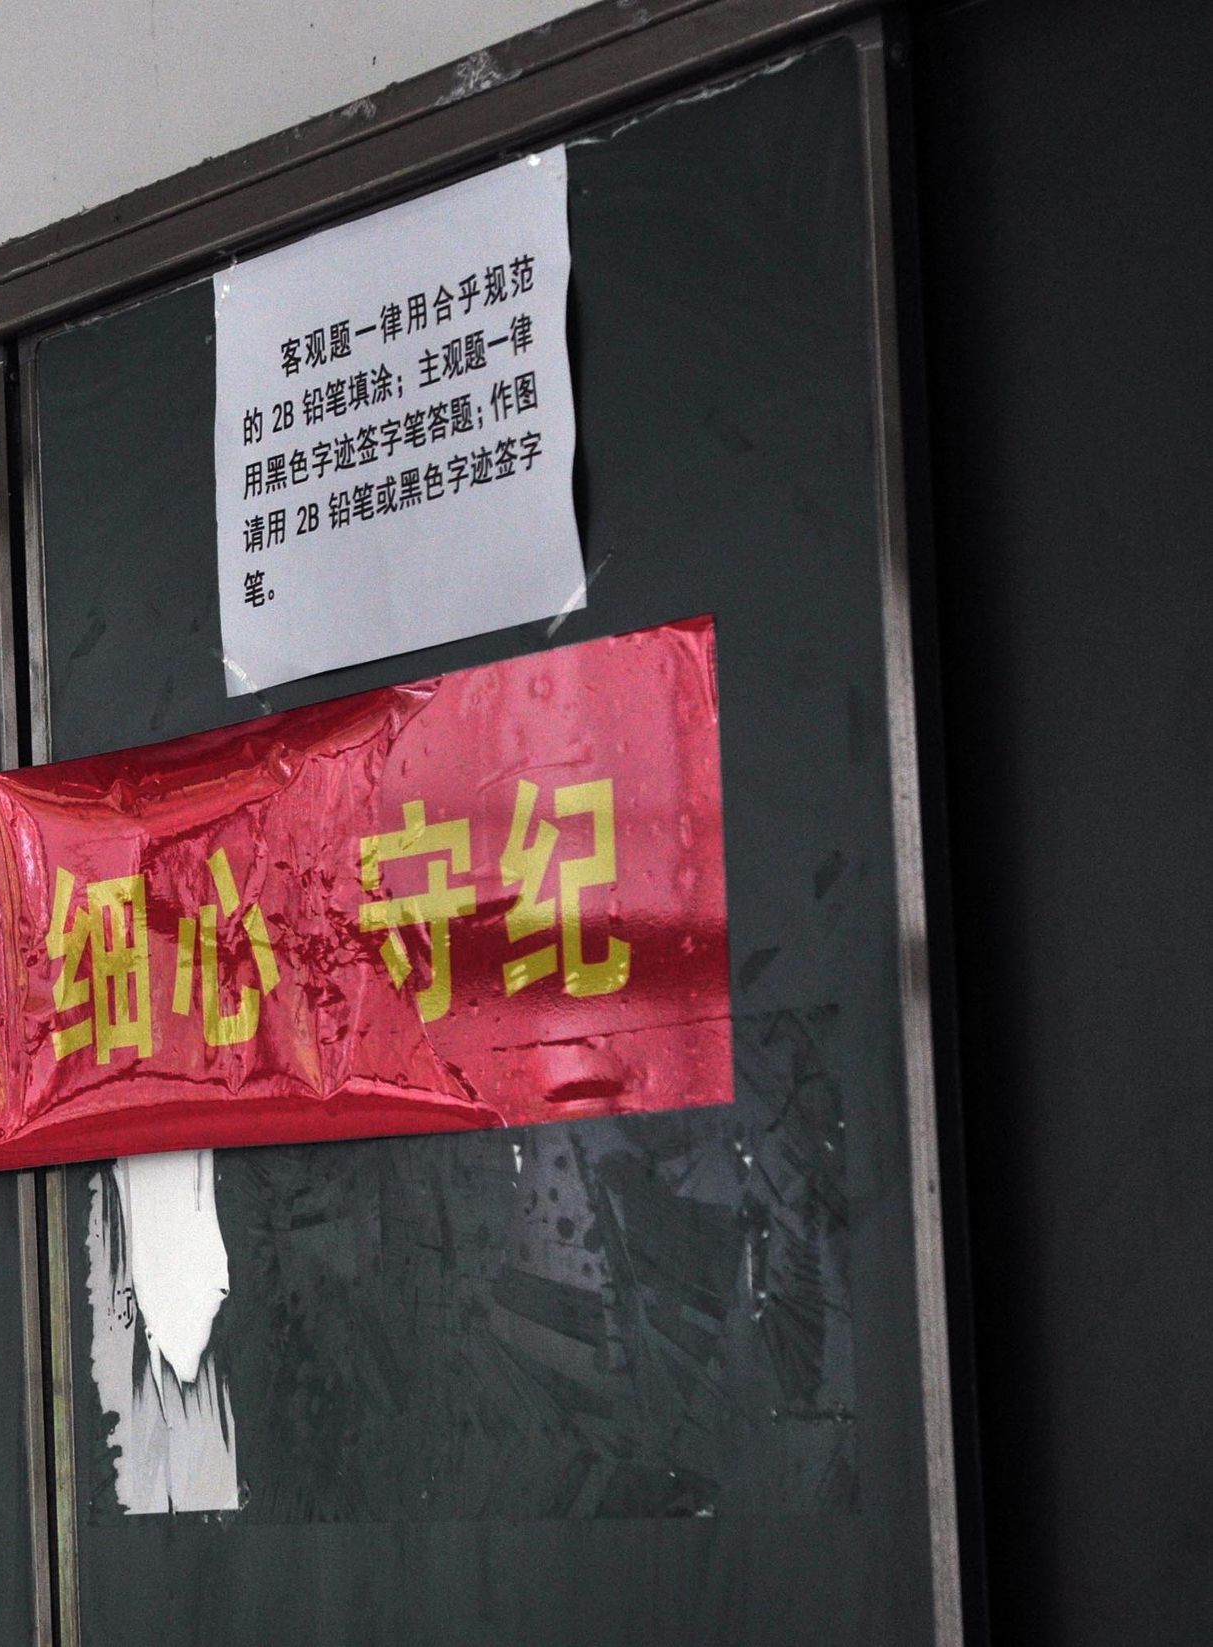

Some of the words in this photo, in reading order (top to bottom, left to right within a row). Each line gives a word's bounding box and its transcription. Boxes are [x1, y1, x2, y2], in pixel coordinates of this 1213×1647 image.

[280, 253, 536, 379] 客观题一律用合乎规范
[243, 406, 264, 447] 的
[272, 399, 295, 434] 2B
[242, 508, 286, 553] 请用
[296, 502, 320, 536] 2B
[328, 429, 544, 531] 铅笔或黑色字迹签字
[243, 569, 276, 609] 笔。
[45, 847, 281, 1065] 细心
[359, 778, 631, 1023] 守纪
